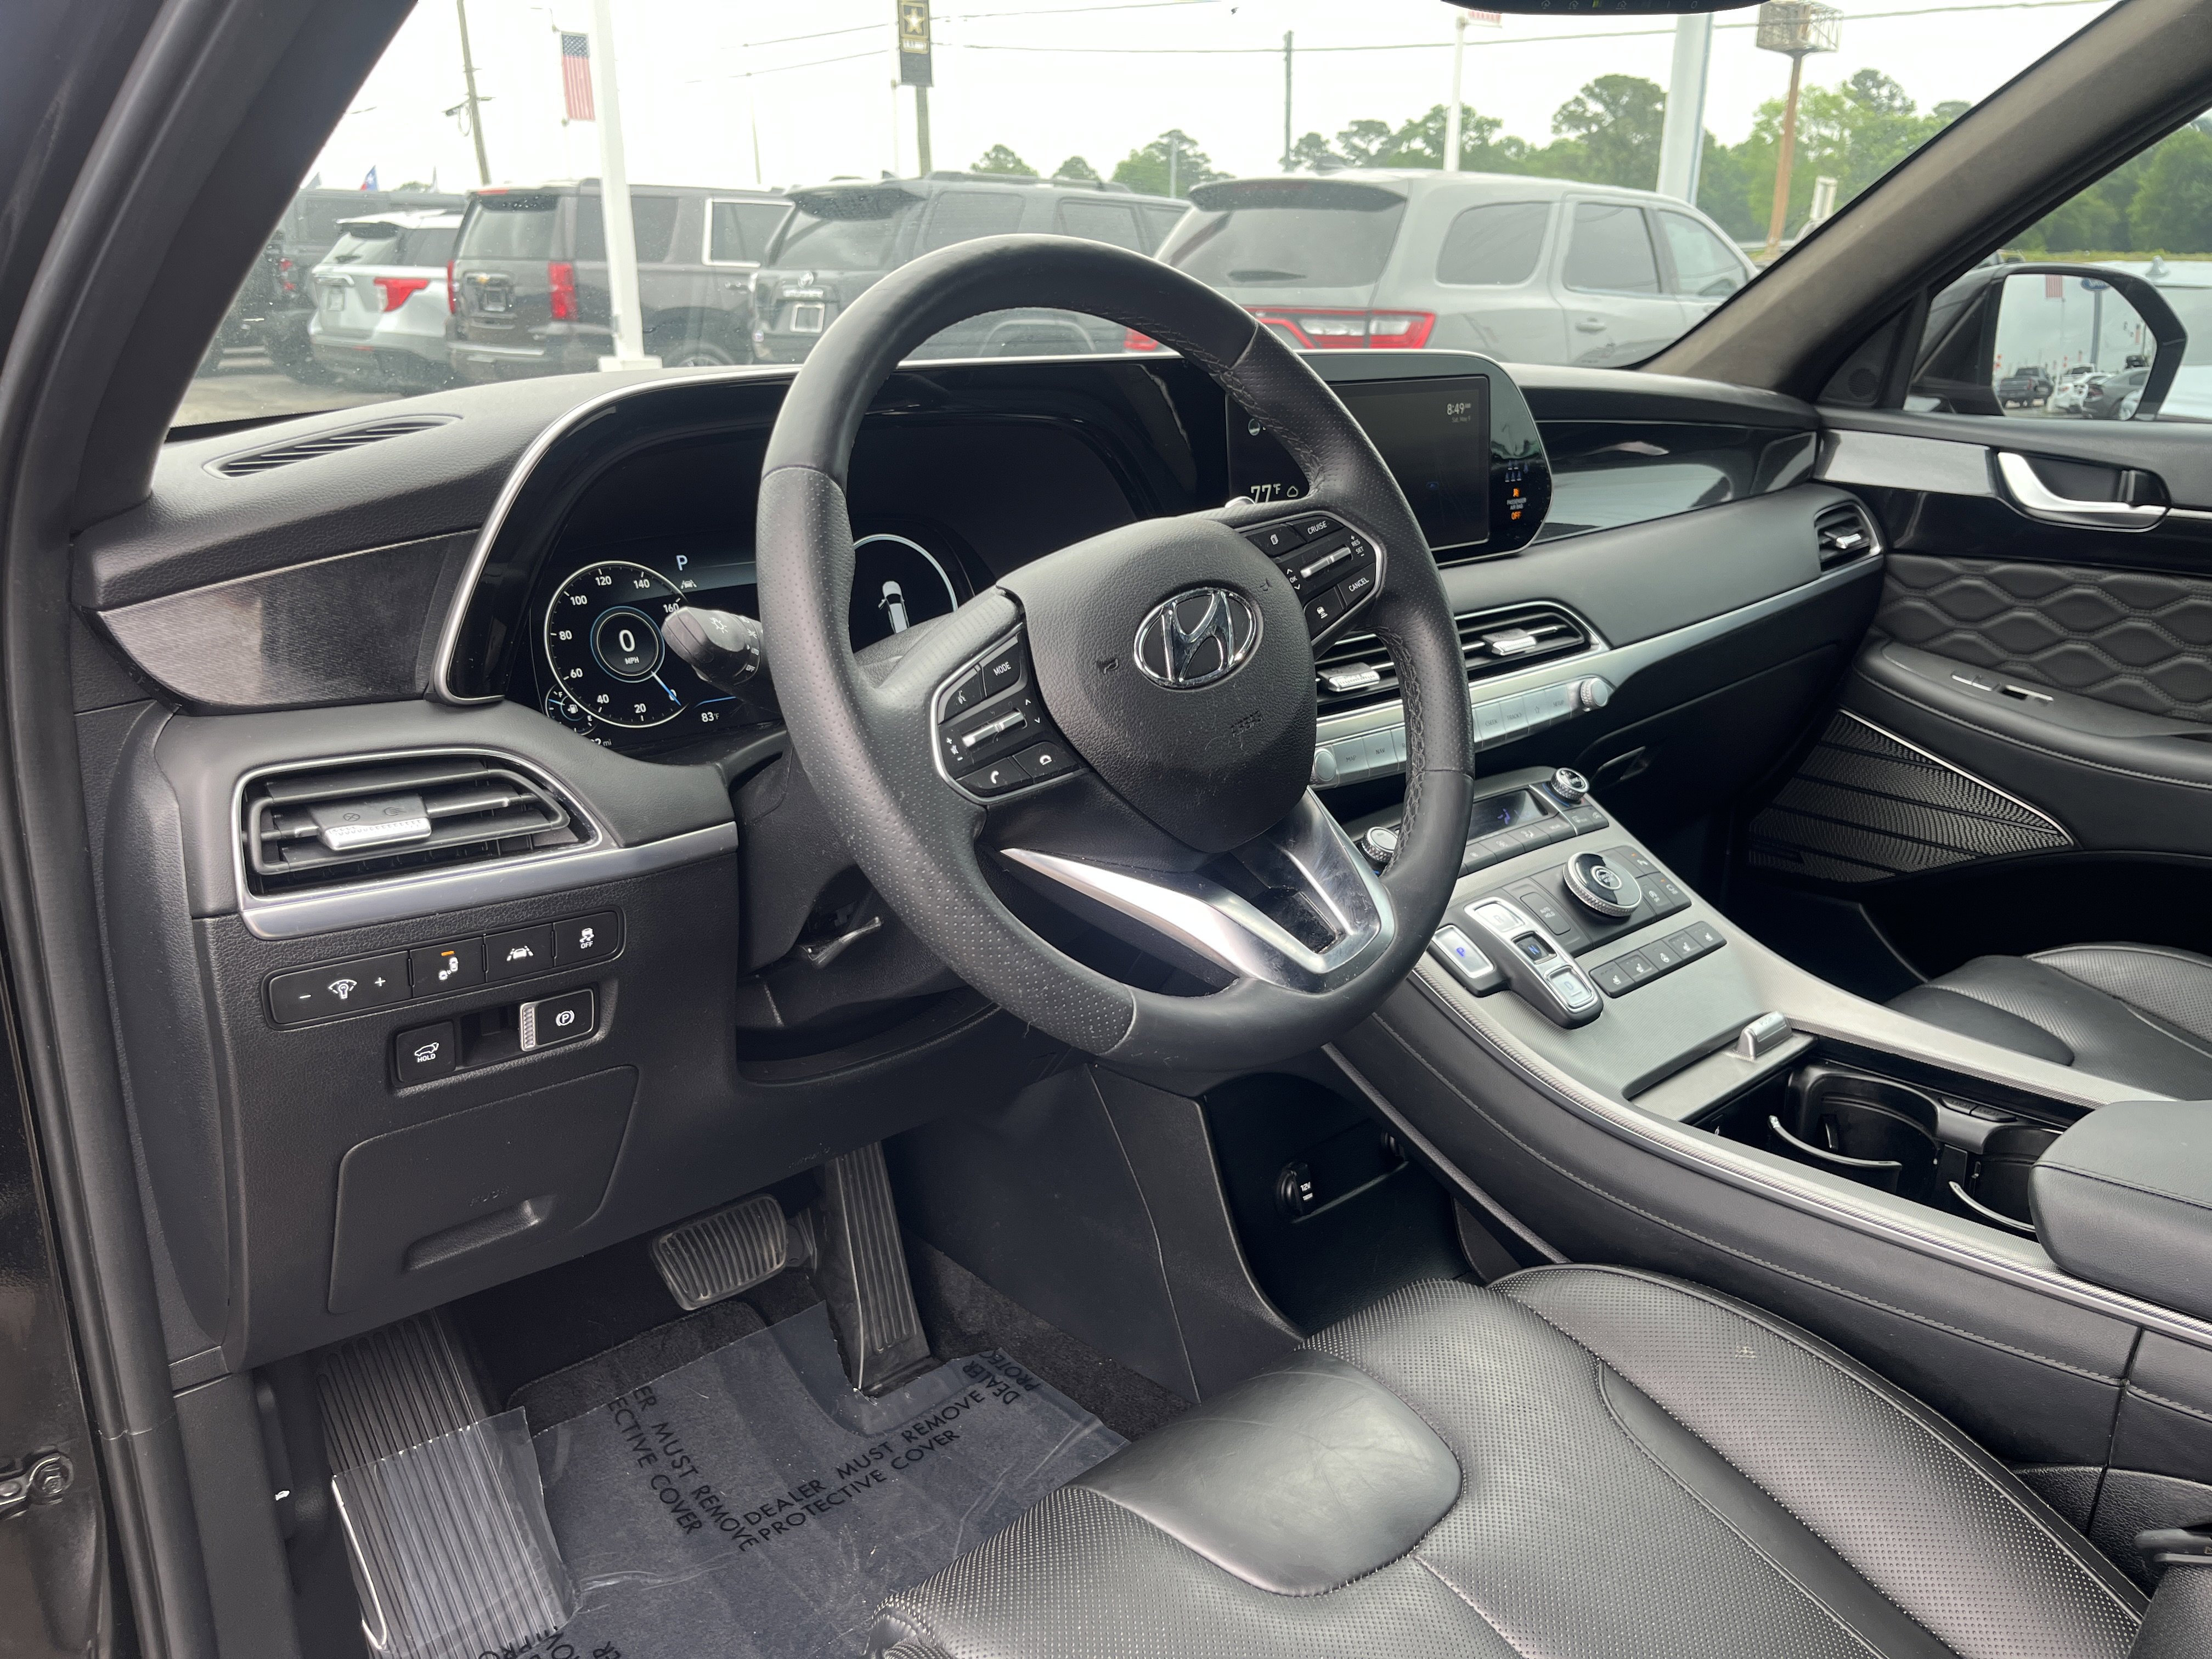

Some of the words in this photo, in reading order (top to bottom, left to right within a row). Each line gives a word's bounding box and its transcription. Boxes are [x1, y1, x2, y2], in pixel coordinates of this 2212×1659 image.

[1447, 403, 1465, 415] 8:49
[1511, 511, 1522, 520] OFF
[1307, 521, 1327, 535] CRUISE
[1351, 539, 1361, 548] RES
[1355, 546, 1364, 554] SET
[676, 555, 688, 571] P
[595, 576, 612, 586] 120
[633, 579, 650, 589] 140
[1348, 577, 1369, 592] CANCEL
[570, 595, 588, 606] 100
[663, 603, 679, 613] 160
[559, 630, 572, 641] 80
[619, 629, 635, 652] 0
[624, 657, 640, 665] MPH
[569, 668, 583, 678] 60
[993, 661, 1012, 676] MODE
[597, 694, 610, 704] 40
[634, 703, 647, 714] 20
[580, 940, 594, 950] OFF
[1528, 945, 1539, 955] N
[1564, 981, 1574, 991] D
[417, 1053, 436, 1063] HOLD
[1300, 1181, 1311, 1192] 12V
[963, 1361, 1020, 1404] DEALER
[744, 1480, 826, 1526] DEALER
[836, 1441, 894, 1480] MUST
[901, 1390, 985, 1443] REMOVE
[651, 1422, 698, 1478] MUST
[691, 1485, 759, 1551] REMOVE
[758, 1469, 888, 1541] PROTECTIVE
[891, 1430, 960, 1470] COVER
[651, 1474, 703, 1534] COVER
